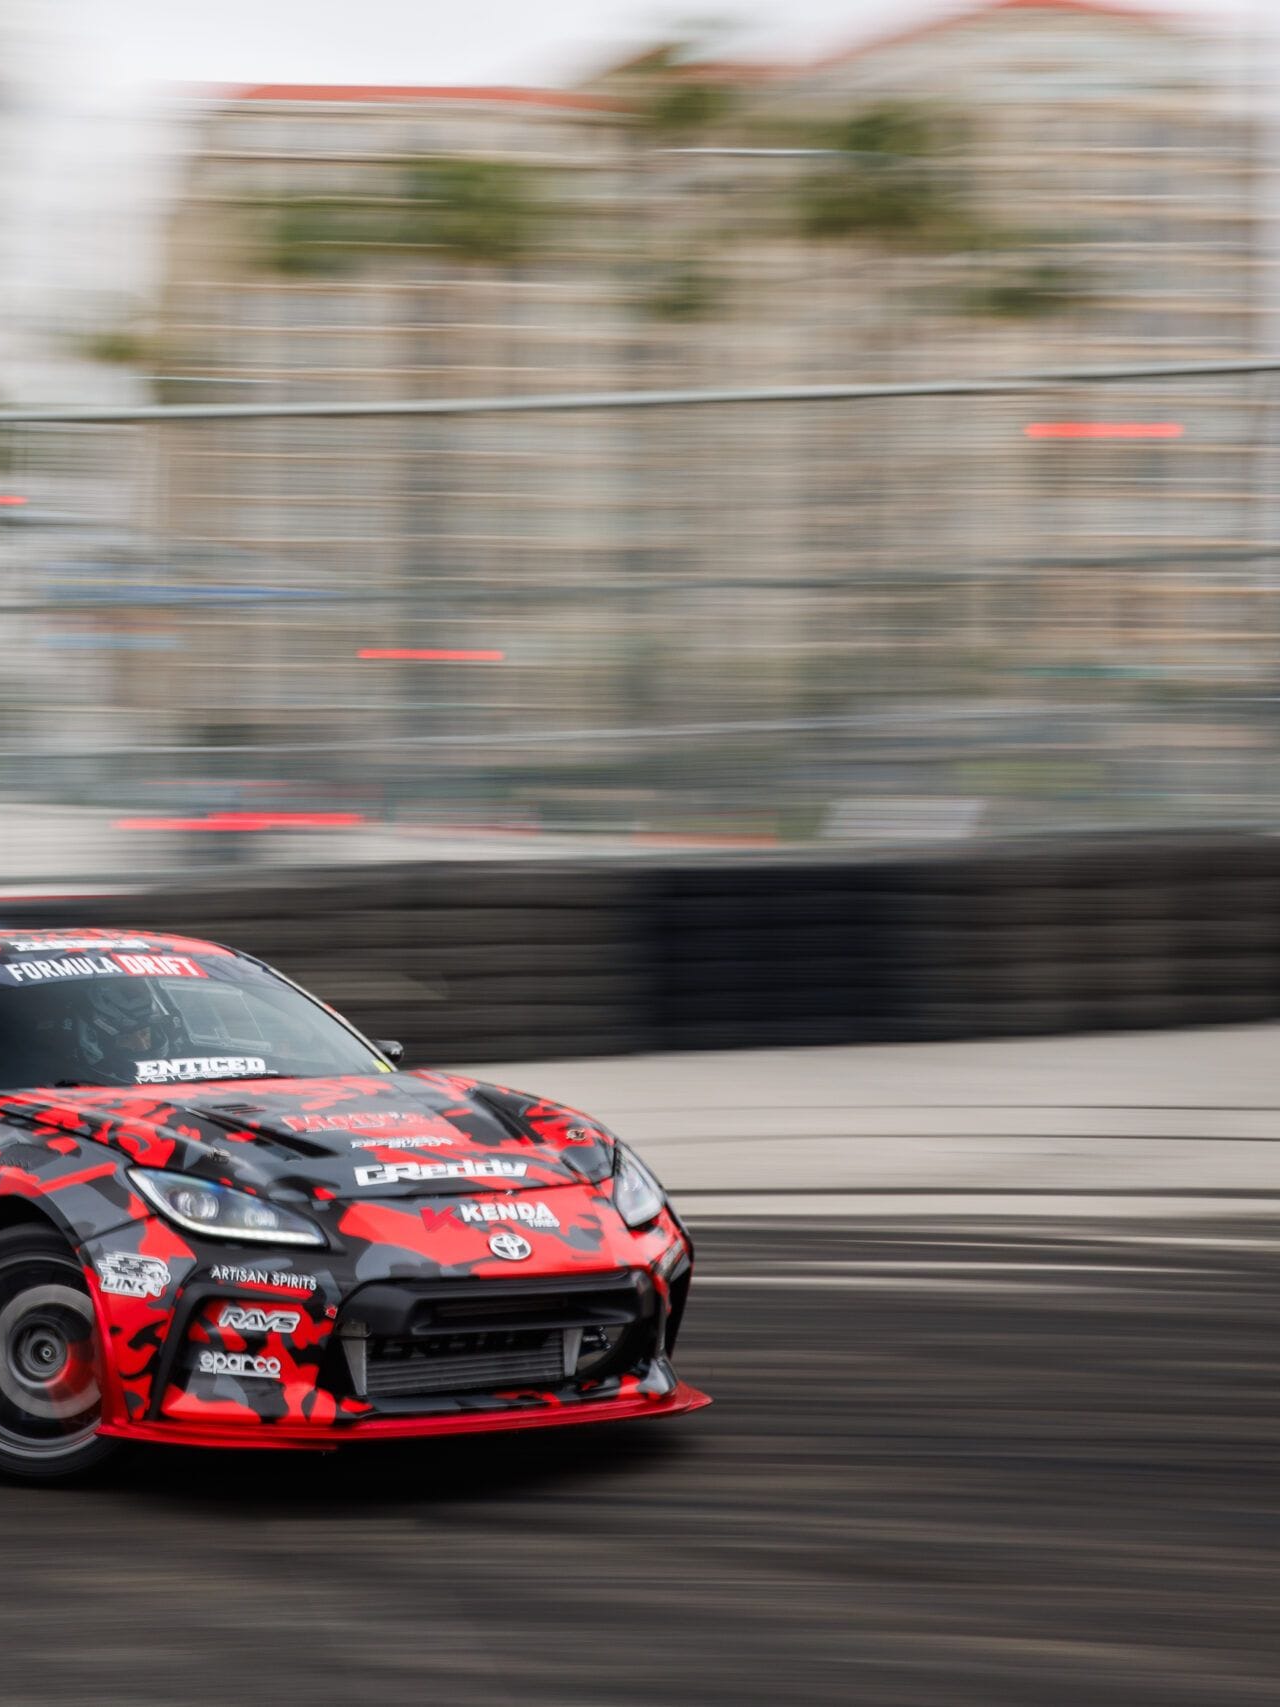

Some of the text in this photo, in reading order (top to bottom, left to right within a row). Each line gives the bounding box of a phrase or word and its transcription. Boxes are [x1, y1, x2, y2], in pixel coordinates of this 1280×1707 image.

[4, 953, 200, 982] FORMULA DRIFT
[135, 1057, 266, 1077] ENTICED
[460, 1202, 558, 1223] KENDA
[210, 1264, 318, 1291] ARTISAN SPIRITS
[219, 1305, 300, 1333] RAYS
[200, 1352, 281, 1375] sparco
